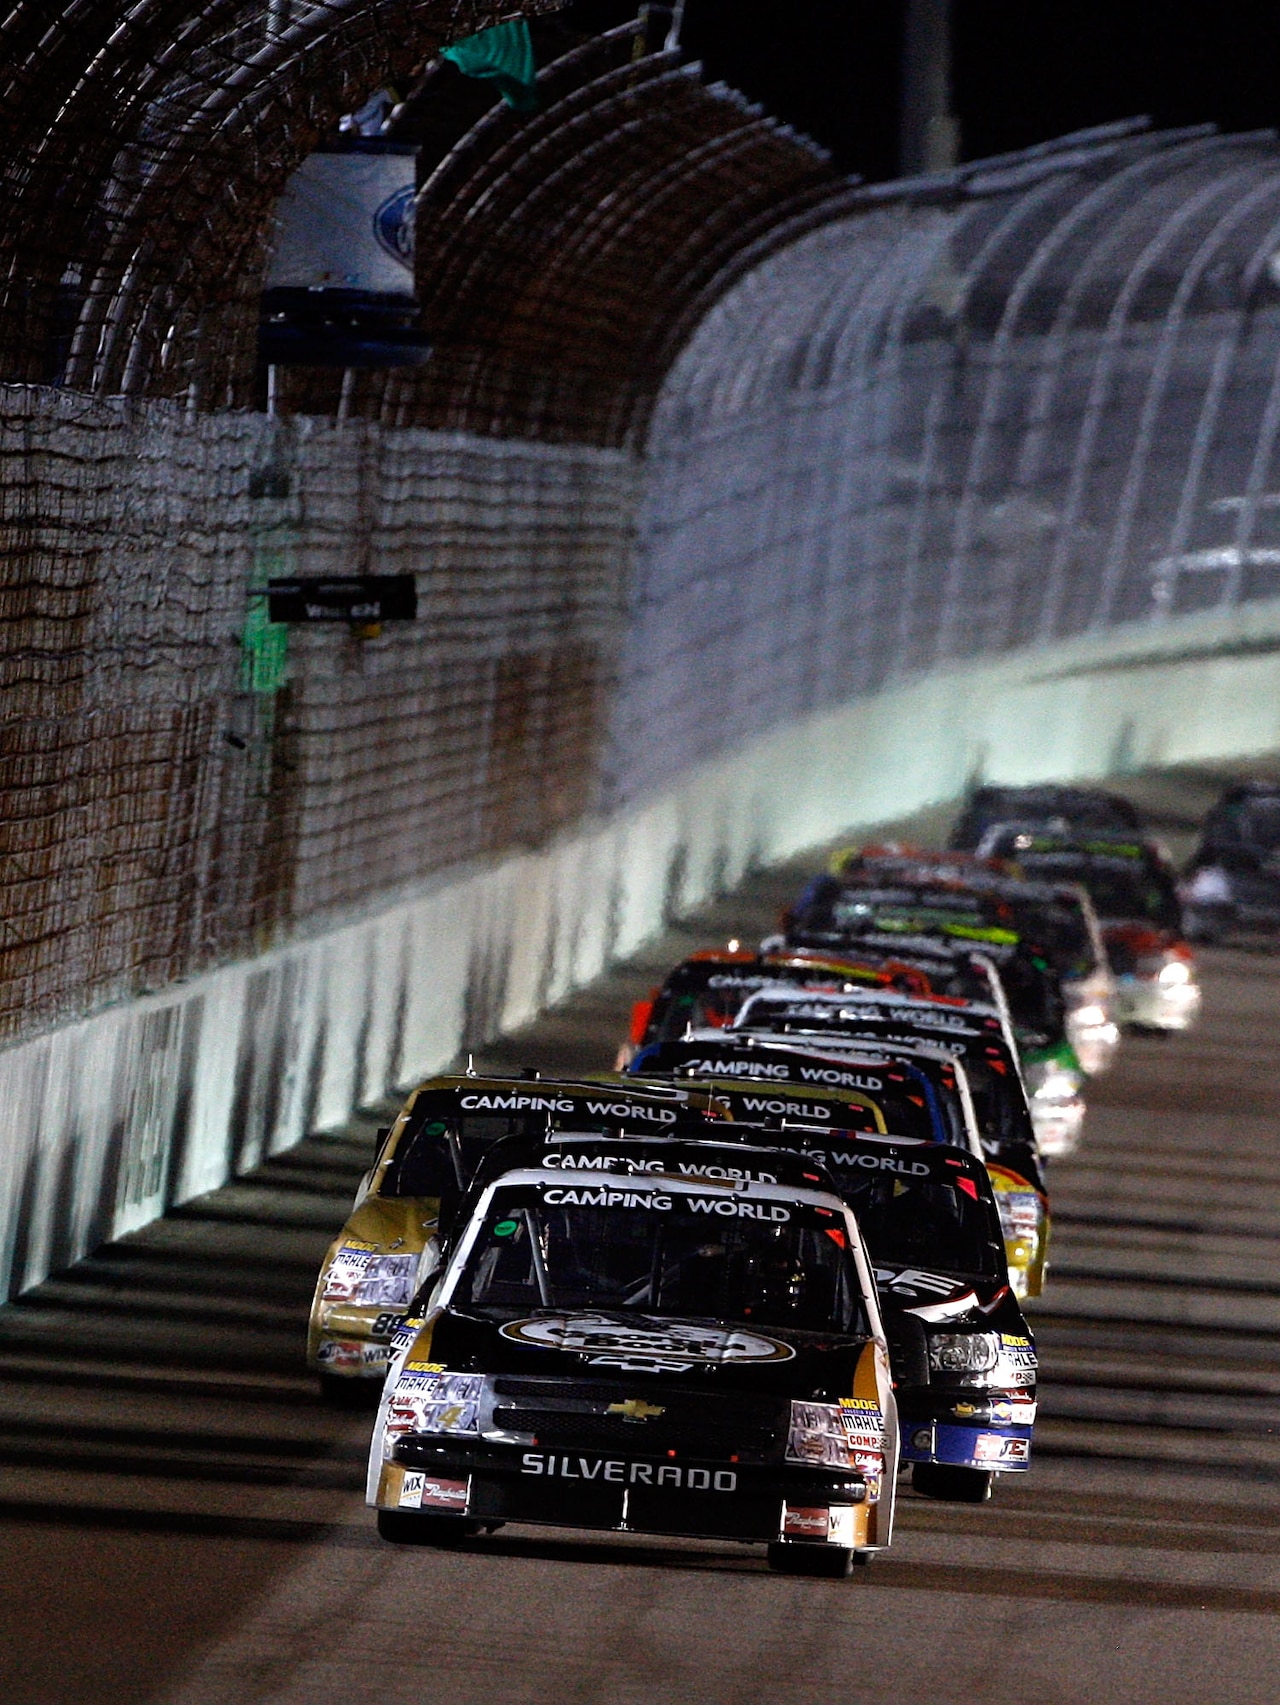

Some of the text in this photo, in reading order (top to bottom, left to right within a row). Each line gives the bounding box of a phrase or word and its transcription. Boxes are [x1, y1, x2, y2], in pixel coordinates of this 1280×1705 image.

[800, 1067, 883, 1091] WORLD
[460, 1095, 677, 1123] CAMPING WORLD
[743, 1098, 831, 1119] WORLD
[832, 1151, 931, 1176] WORLD
[543, 1188, 791, 1222] CAMPING WORLD
[332, 1253, 370, 1269] MAHLE
[364, 1347, 391, 1364] WIX
[405, 1361, 448, 1373] MOOG
[395, 1377, 439, 1392] MAHLE
[838, 1398, 879, 1411] MOOG
[840, 1416, 886, 1432] MAHLE
[849, 1435, 877, 1447] COMP
[521, 1453, 738, 1492] SILVERADO
[402, 1475, 423, 1493] WIX
